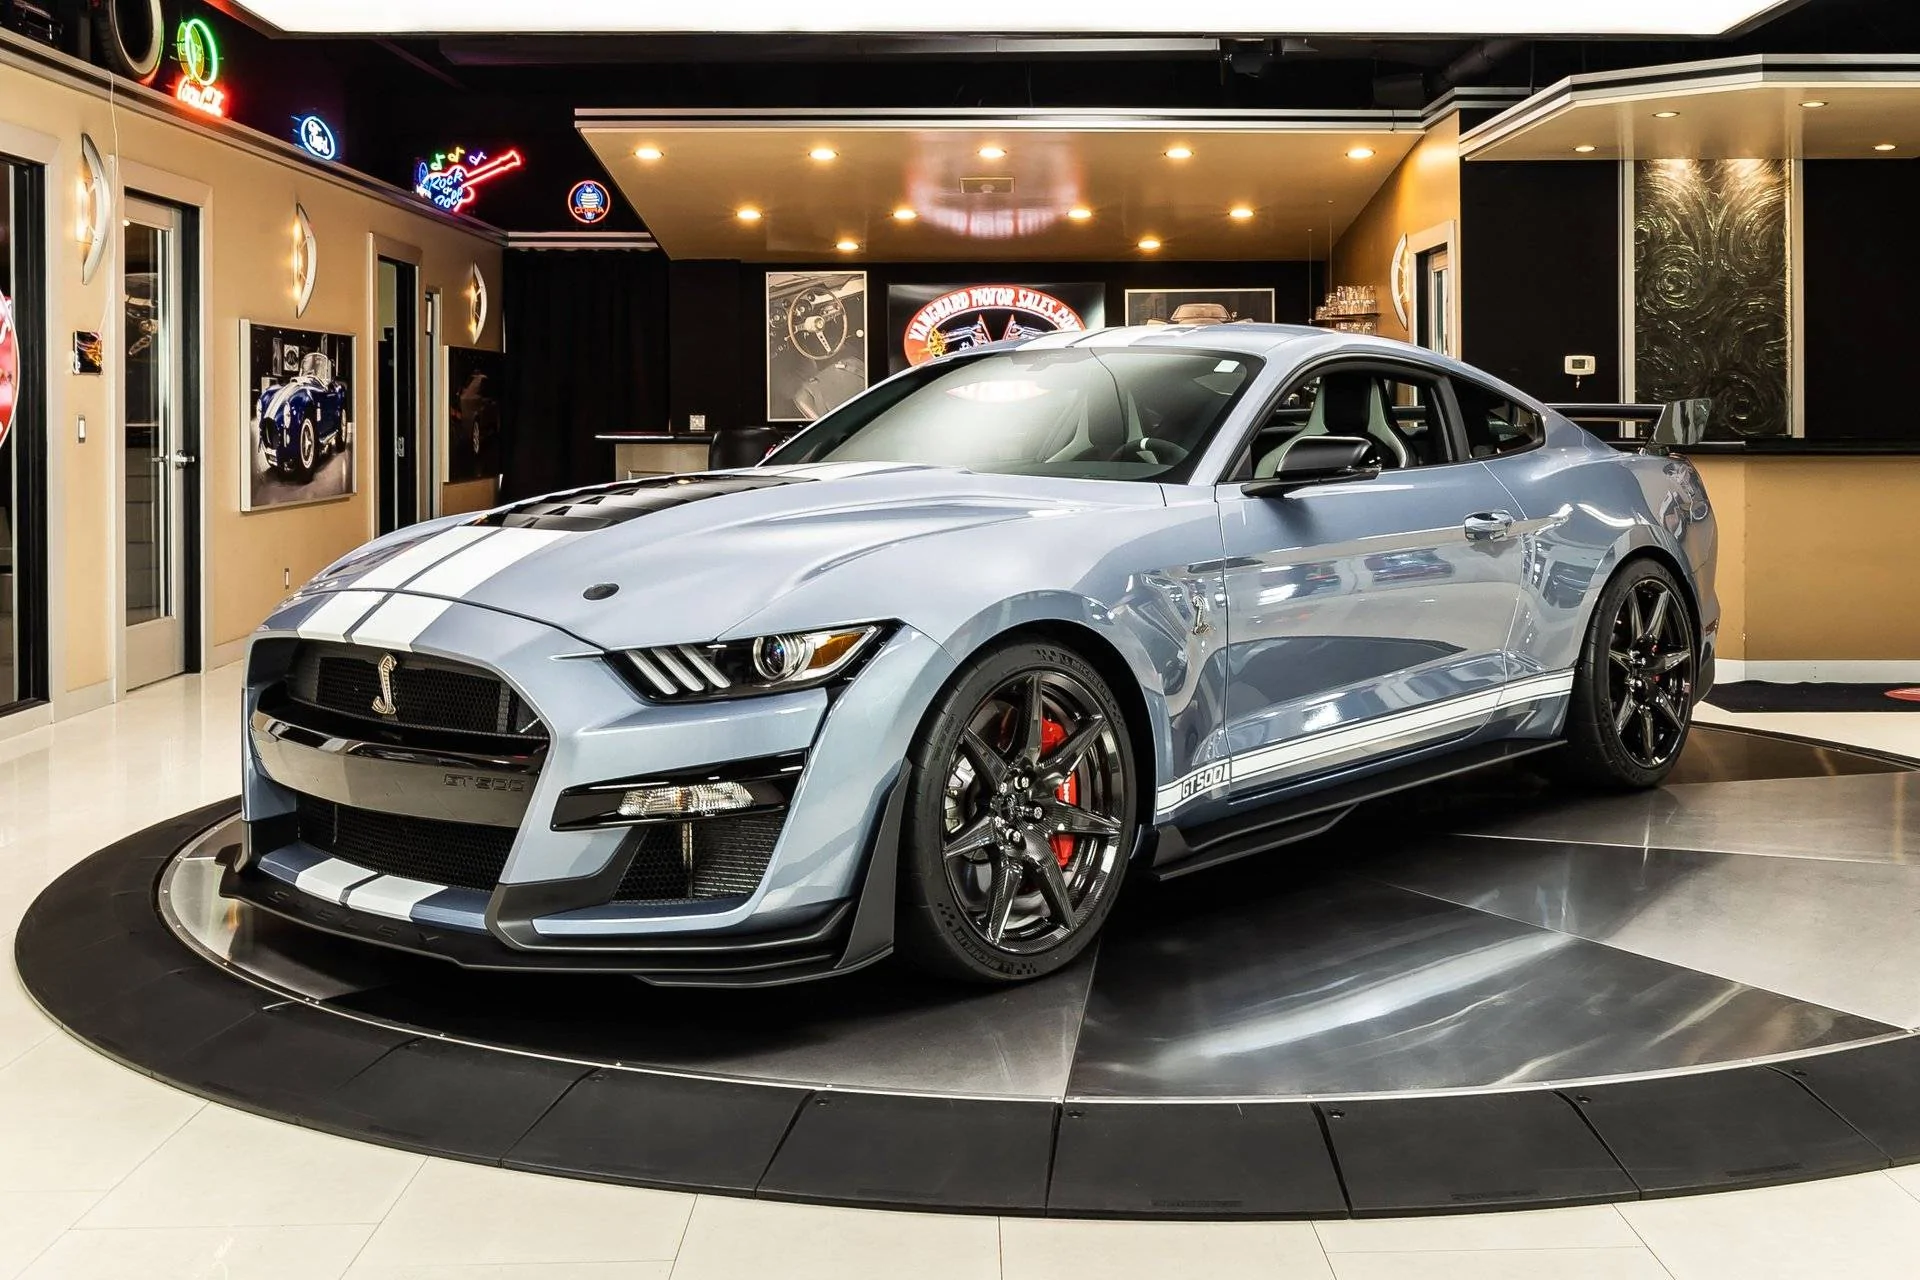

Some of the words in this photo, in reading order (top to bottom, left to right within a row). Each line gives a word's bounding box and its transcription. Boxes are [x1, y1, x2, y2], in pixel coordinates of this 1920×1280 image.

[429, 168, 463, 190] Rock
[908, 291, 970, 342] VANGUARD
[970, 287, 1016, 307] MOTOR
